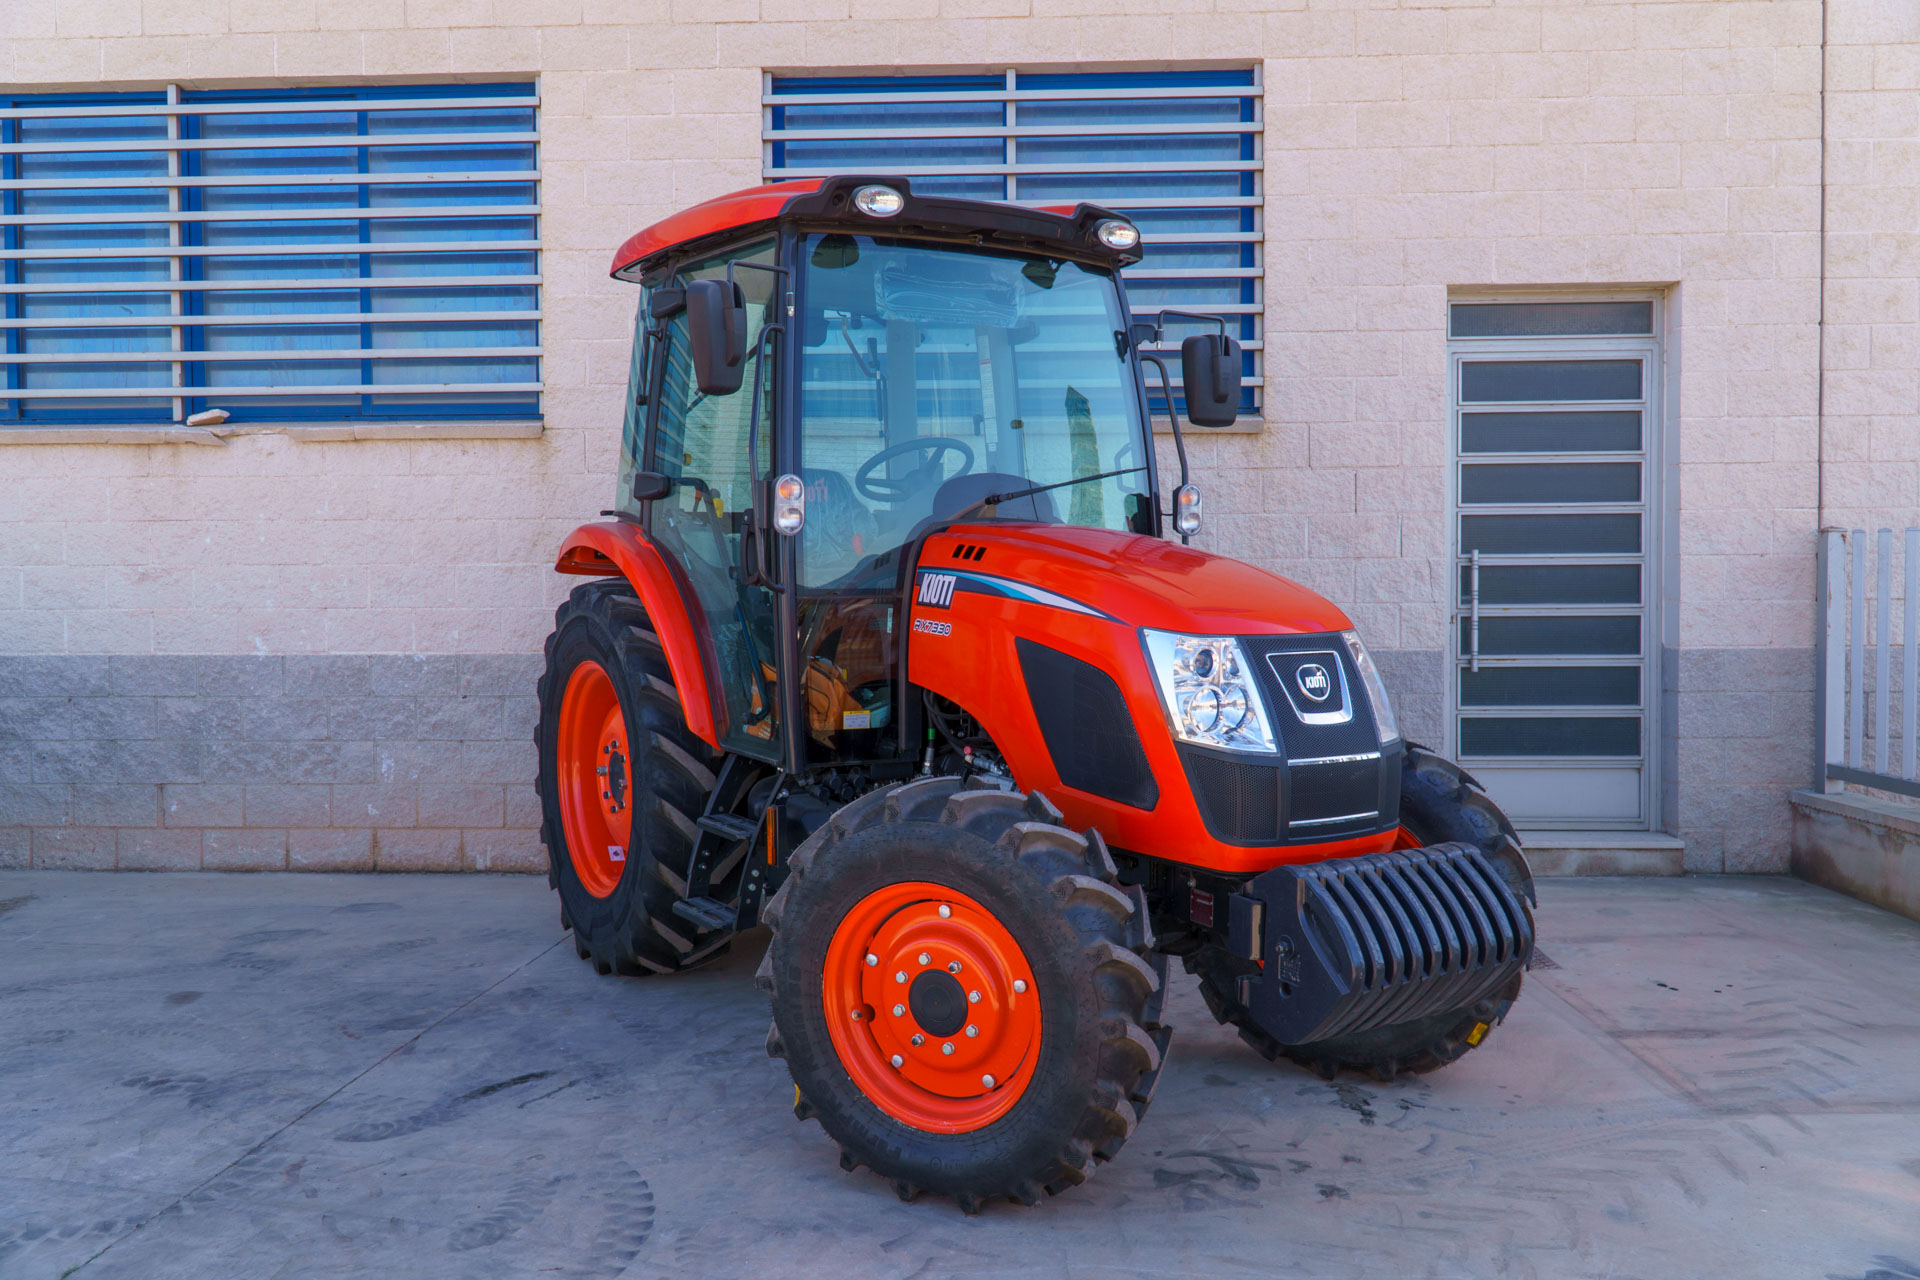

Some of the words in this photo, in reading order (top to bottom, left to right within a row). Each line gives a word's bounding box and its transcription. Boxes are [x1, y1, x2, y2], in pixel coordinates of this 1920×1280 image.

[918, 572, 957, 606] KIOTI
[913, 618, 952, 637] RX7330
[1305, 671, 1327, 689] KIOTI
